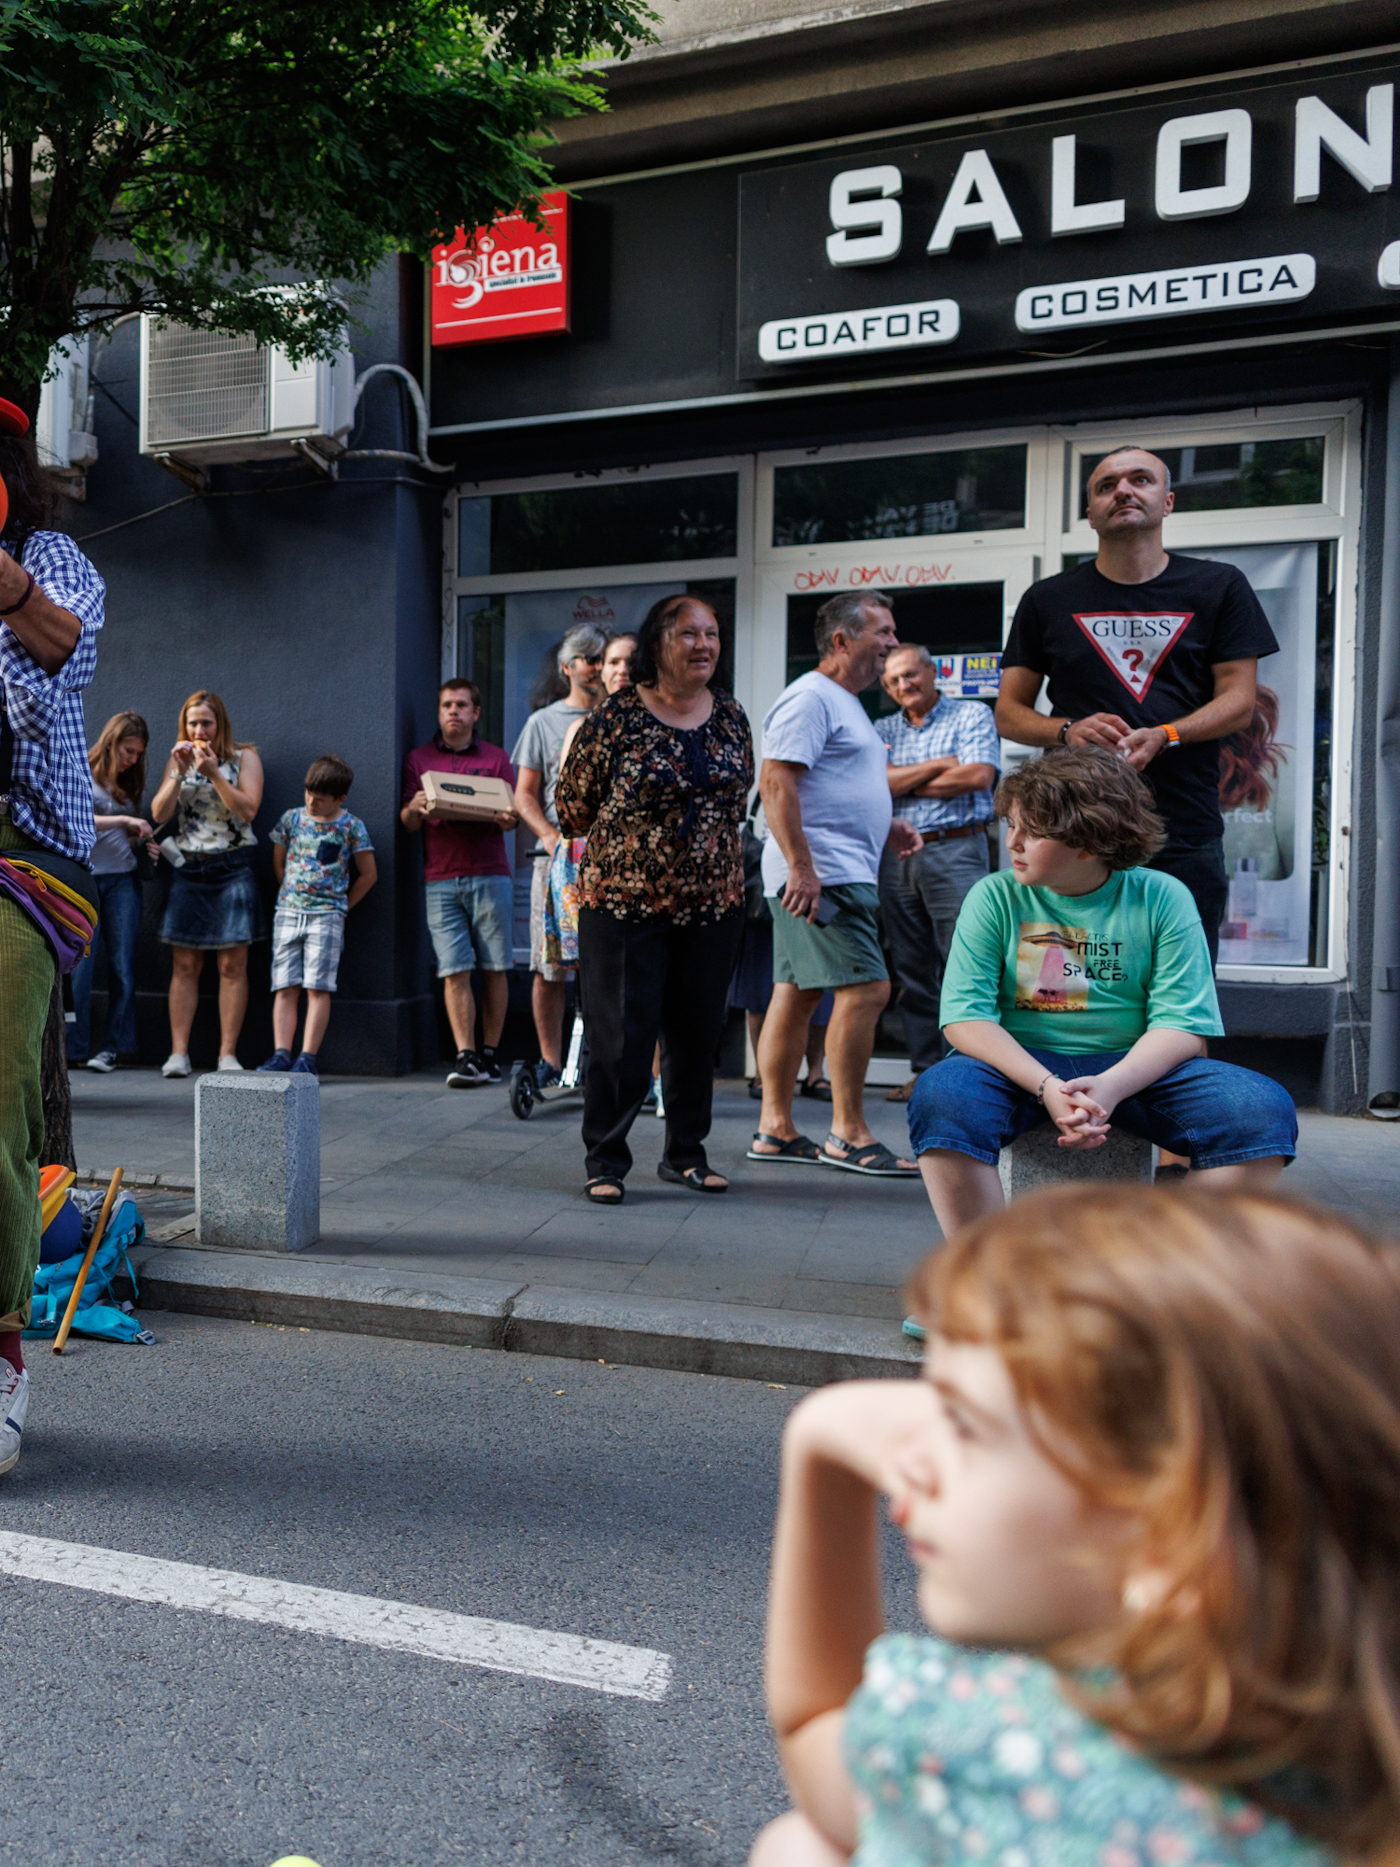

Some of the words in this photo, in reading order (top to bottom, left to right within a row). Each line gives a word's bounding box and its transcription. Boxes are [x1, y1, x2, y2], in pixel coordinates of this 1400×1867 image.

[826, 83, 1394, 268] SALON
[436, 236, 562, 309] igiena
[1030, 264, 1298, 320] COSMETICA
[777, 309, 941, 351] COAFOR
[1092, 619, 1171, 638] GUESS
[1077, 942, 1123, 957] MIST
[1093, 959, 1120, 968] FREE
